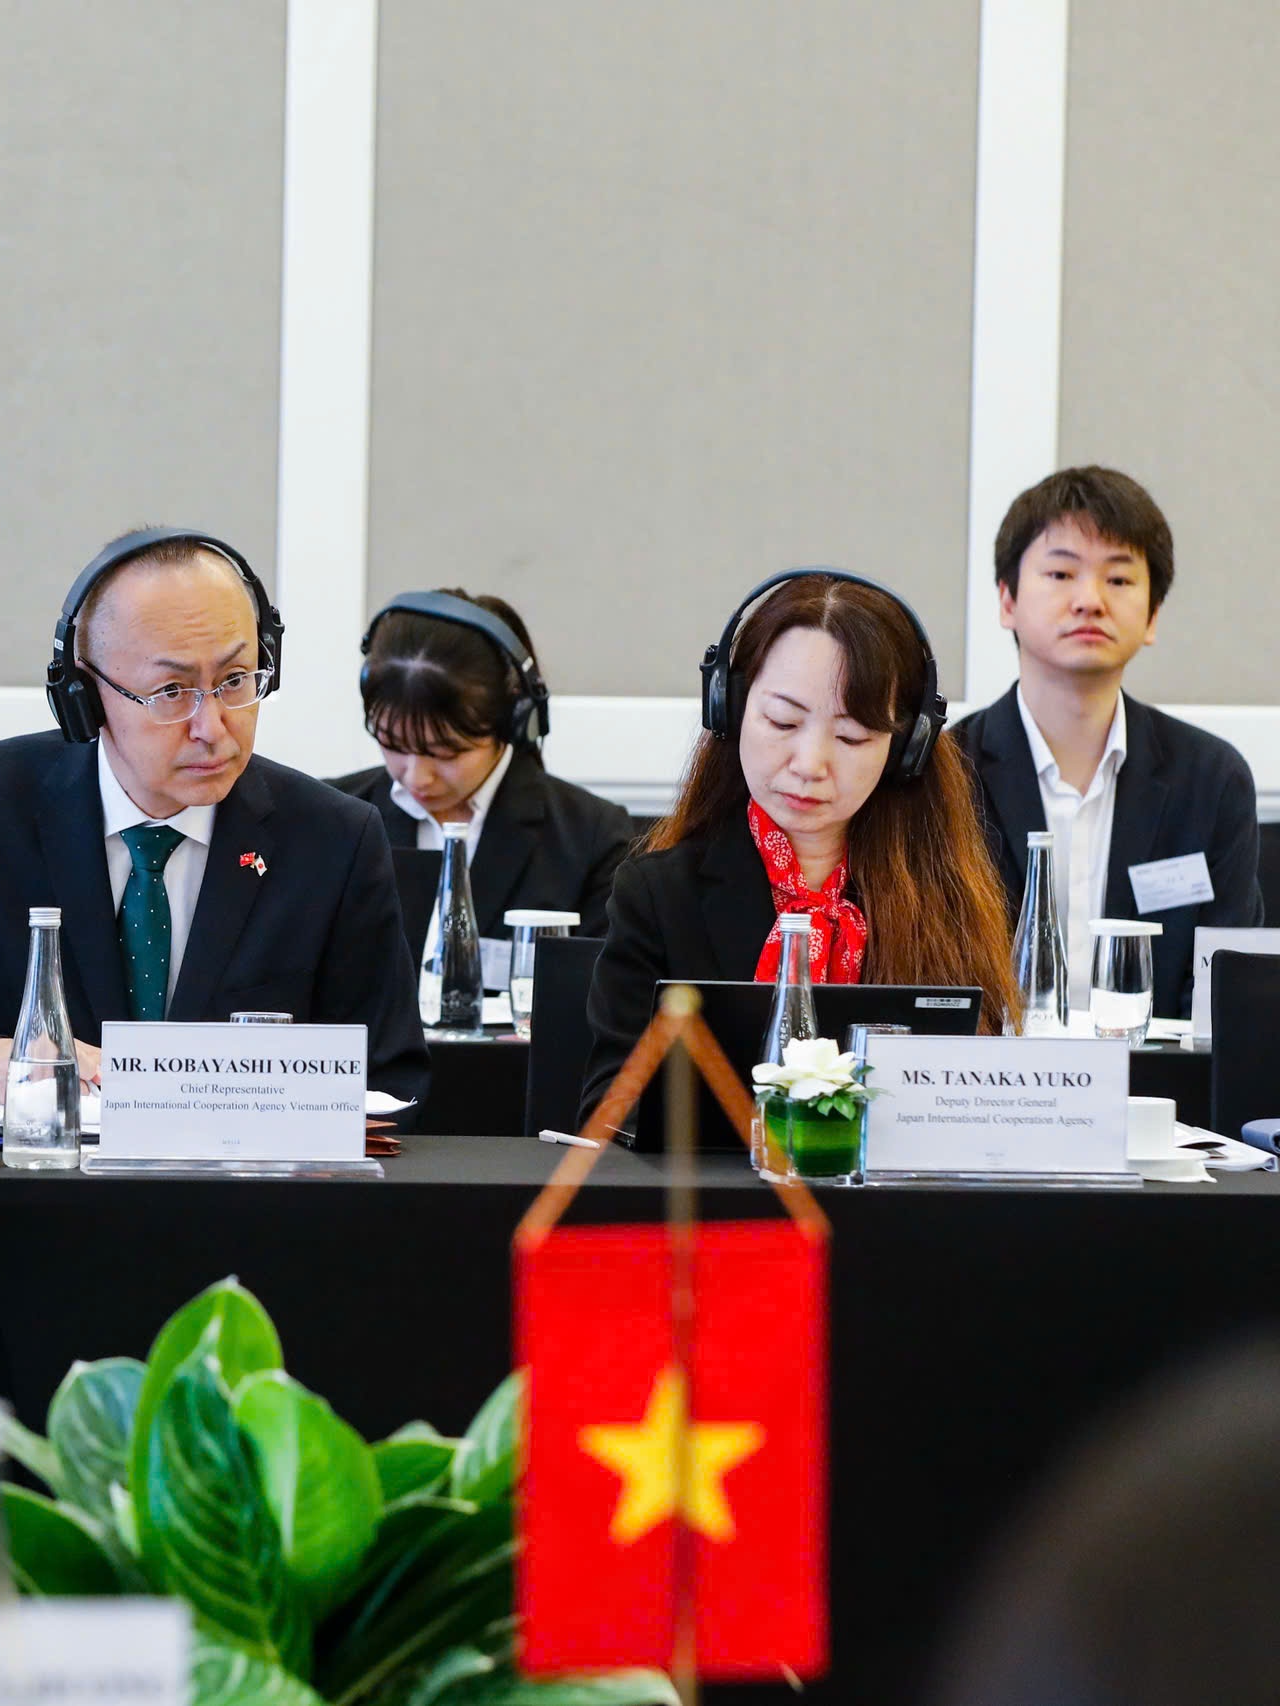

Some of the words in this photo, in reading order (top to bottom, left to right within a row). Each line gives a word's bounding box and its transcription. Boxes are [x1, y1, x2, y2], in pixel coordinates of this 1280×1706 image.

[110, 1057, 148, 1073] MR.
[154, 1057, 272, 1075] KOBAYASHI
[279, 1059, 362, 1076] YOSUKE
[902, 1069, 936, 1086] MS.
[941, 1070, 1026, 1087] TANAKA
[1033, 1072, 1092, 1088] YUKO
[180, 1083, 209, 1095] Chief
[211, 1083, 285, 1097] Representative
[104, 1099, 131, 1112] Japan
[133, 1099, 191, 1111] International
[193, 1100, 249, 1113] Cooperation
[252, 1101, 286, 1114] Agency
[289, 1101, 329, 1112] Vietnam
[330, 1101, 360, 1113] Office
[935, 1095, 971, 1110] Deputy
[974, 1096, 1015, 1108] Director
[1018, 1096, 1057, 1108] General
[895, 1112, 925, 1125] Japan
[927, 1112, 990, 1125] International
[993, 1113, 1054, 1127] Cooperation
[1057, 1114, 1095, 1128] Agency
